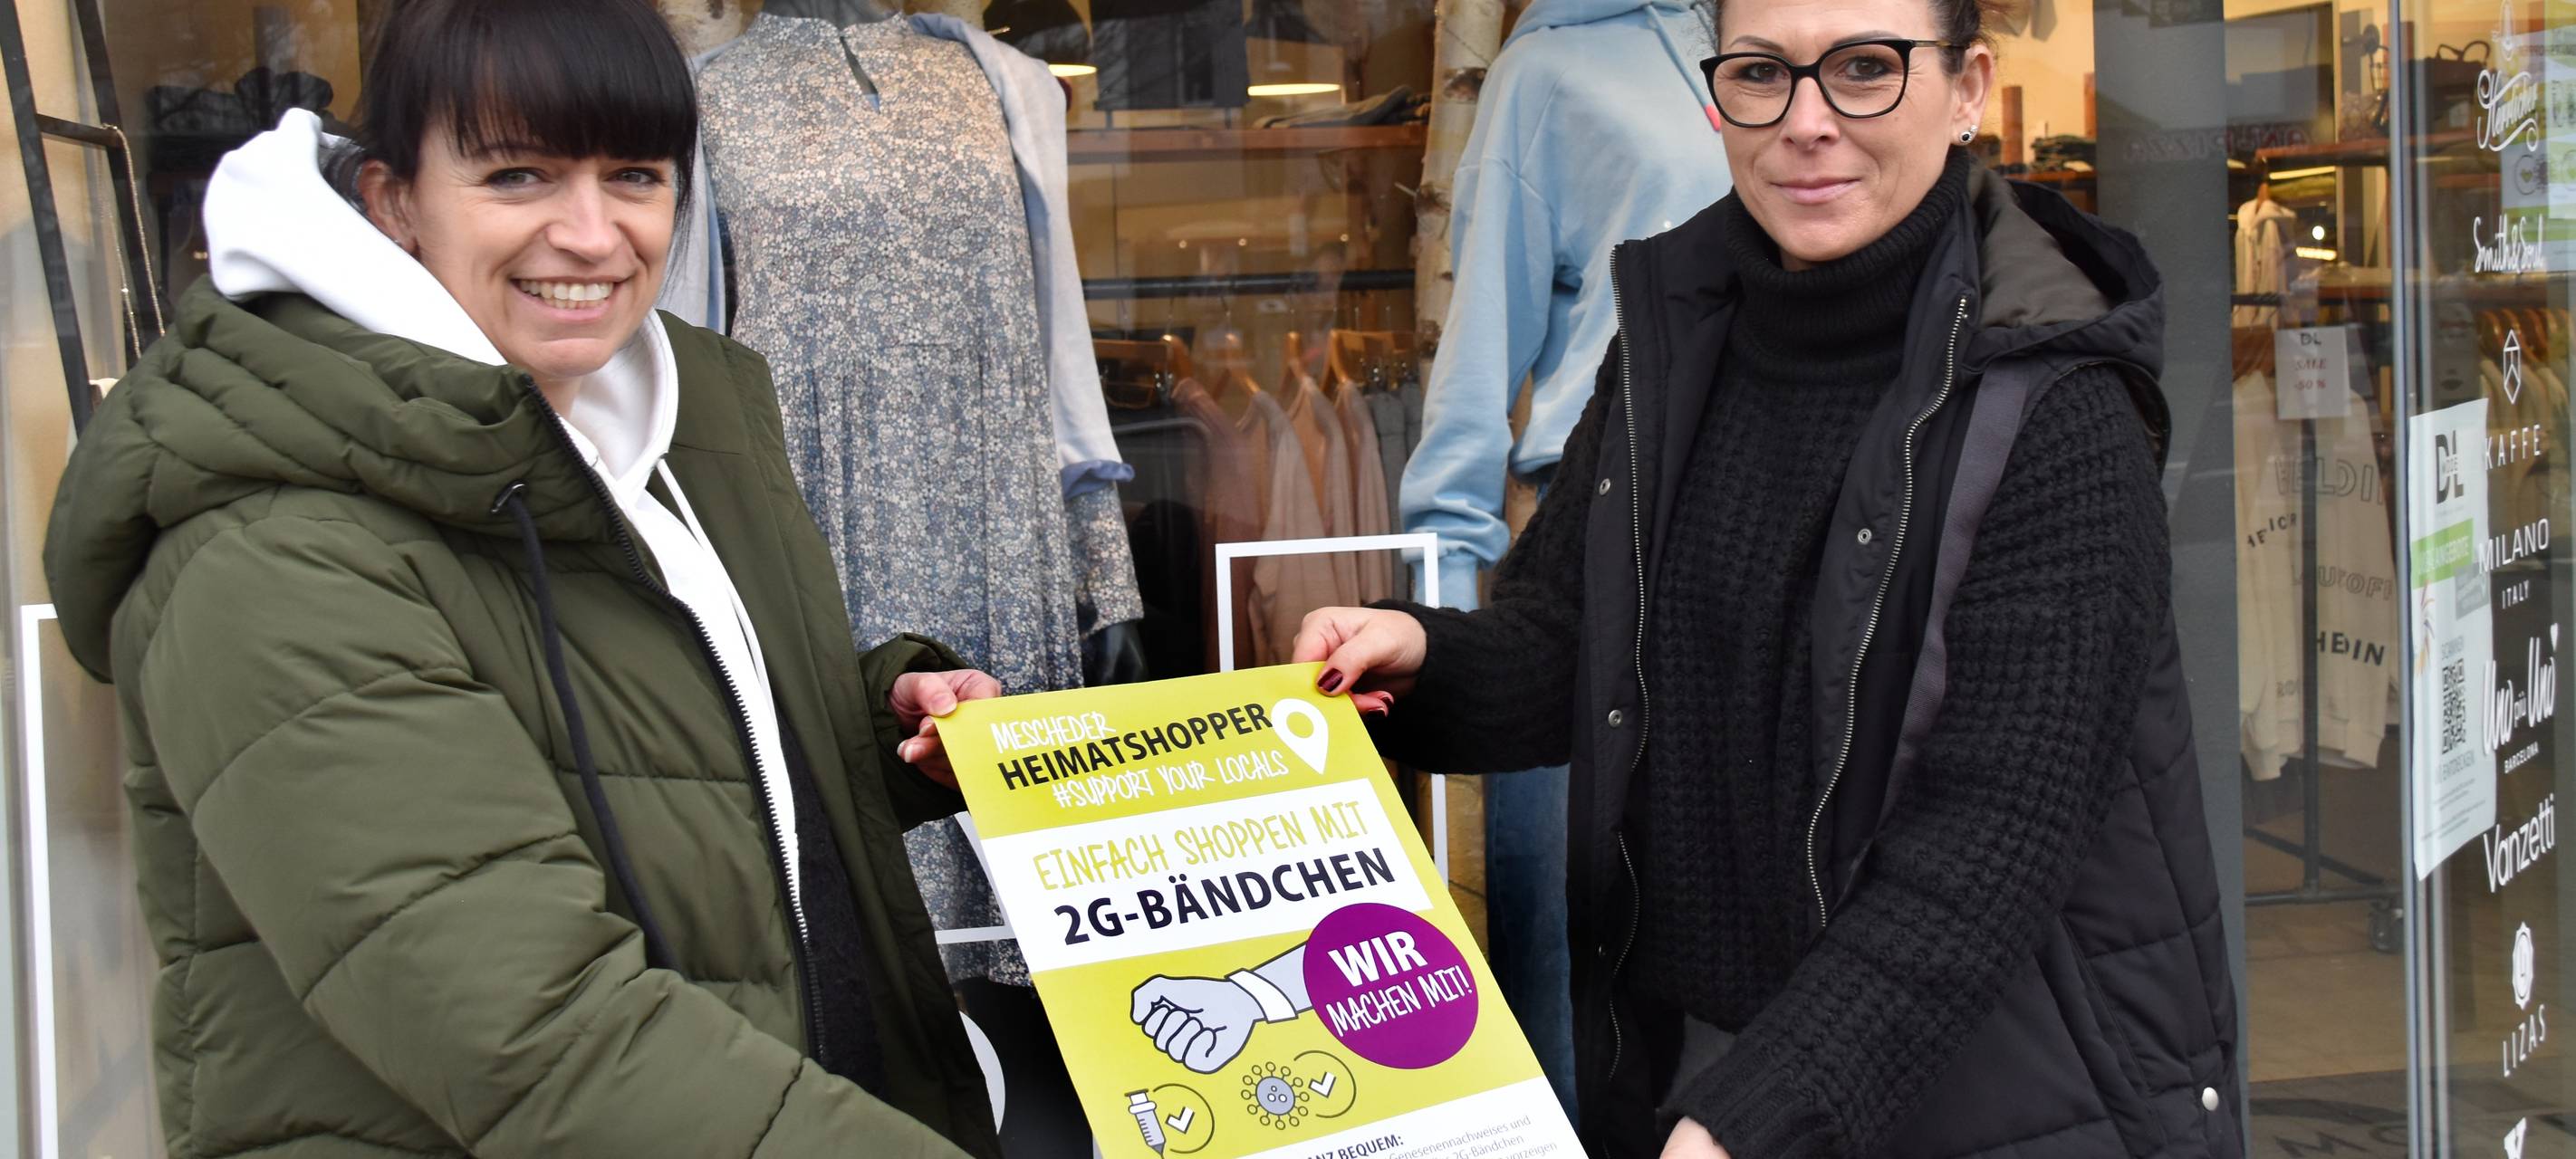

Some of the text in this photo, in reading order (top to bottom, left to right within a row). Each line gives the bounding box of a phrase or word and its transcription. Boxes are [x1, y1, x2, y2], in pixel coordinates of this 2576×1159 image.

[2485, 424, 2542, 471] KAFFE
[2478, 518, 2549, 575] MILANO
[2503, 580, 2530, 609] ITALY
[992, 711, 1116, 753] MESCHEDER
[997, 703, 1273, 790] HEIMATSHOPPER
[2504, 741, 2539, 774] BARCELONA
[1052, 750, 1289, 808] #SUPPORT YOUR LOCALS
[1033, 800, 1369, 890] EINFACH SHOPPEN MIT
[2483, 793, 2555, 893] Vanzetti
[1053, 847, 1396, 945] 2G-BÄNDCHEN
[1327, 931, 1428, 987] WIR
[1325, 964, 1473, 1037] MACHEN MIT!
[2503, 1005, 2546, 1078] LIZAS
[1337, 1135, 1404, 1159] BEQUEM:
[1389, 1116, 1532, 1159] Genesenennachweises und
